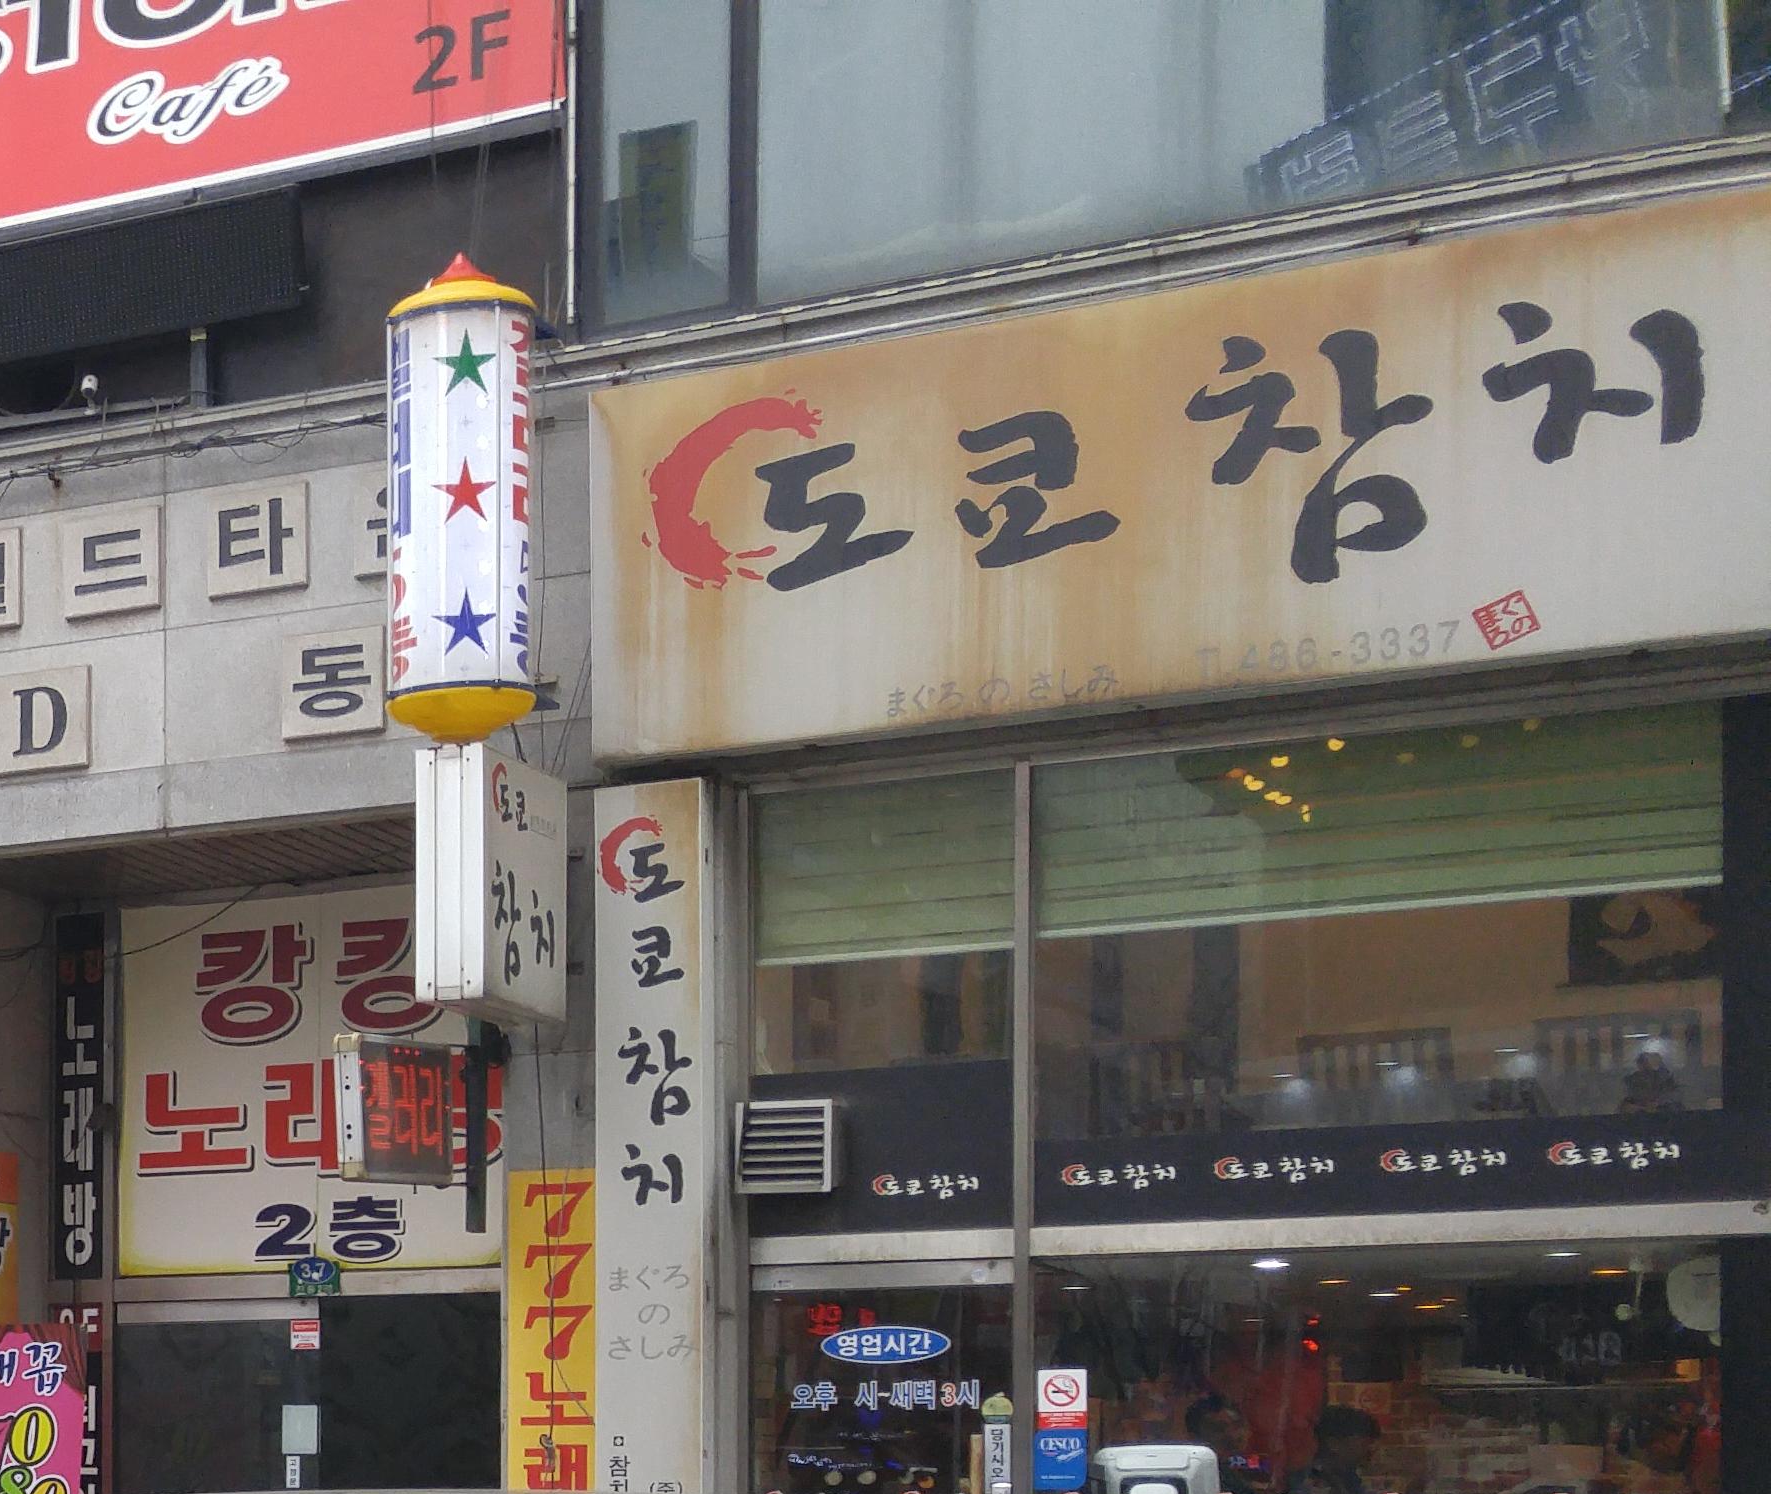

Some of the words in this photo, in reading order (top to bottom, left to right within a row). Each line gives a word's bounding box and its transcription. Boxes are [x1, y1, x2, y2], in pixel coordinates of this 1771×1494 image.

[412, 10, 510, 94] 2F
[91, 58, 287, 142] Café
[12, 686, 67, 758] D
[293, 644, 372, 718] 동
[618, 843, 692, 1206] 도코참치
[62, 995, 98, 1266] 노래방
[255, 1196, 403, 1261] 2층
[837, 1332, 932, 1358] 영업시간
[791, 1382, 837, 1412] 오후
[941, 1378, 980, 1410] 3시
[1040, 1437, 1081, 1452] CESCO
